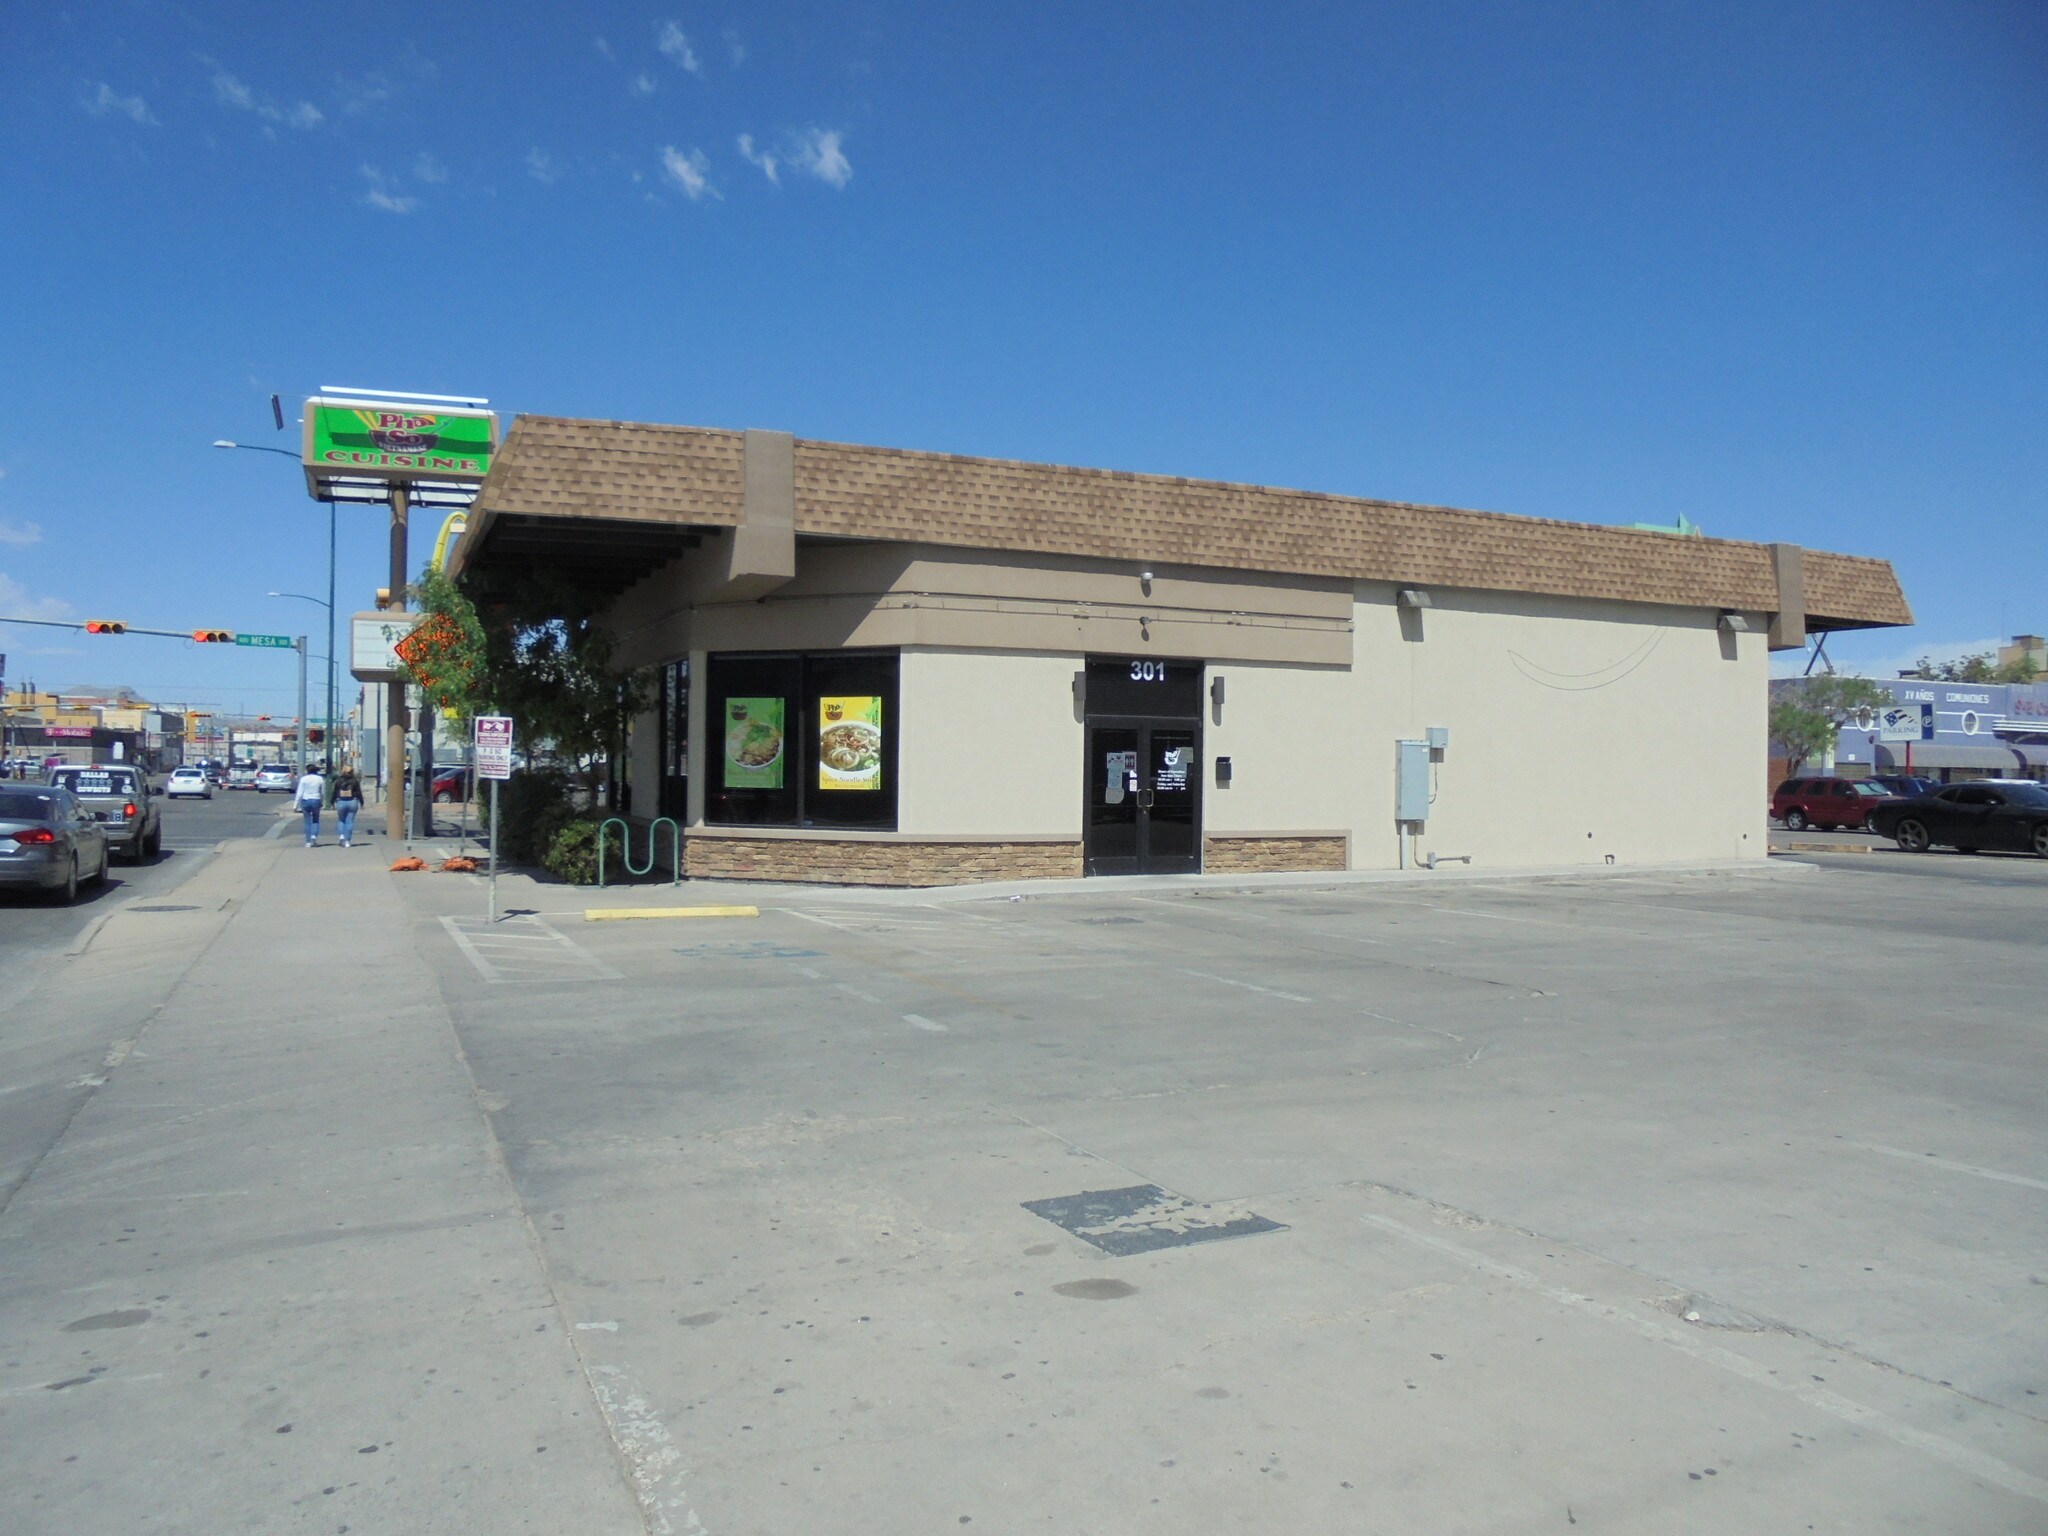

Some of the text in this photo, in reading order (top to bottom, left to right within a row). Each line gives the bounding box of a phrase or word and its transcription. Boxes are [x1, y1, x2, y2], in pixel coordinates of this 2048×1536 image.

[379, 442, 428, 452] VIETNAMESE
[325, 451, 479, 470] CUISINE
[251, 636, 276, 646] MESA
[1130, 660, 1165, 681] 301
[1904, 690, 1917, 699] XV
[1946, 692, 1989, 704] COMUNIONES
[80, 771, 109, 779] DALLAS
